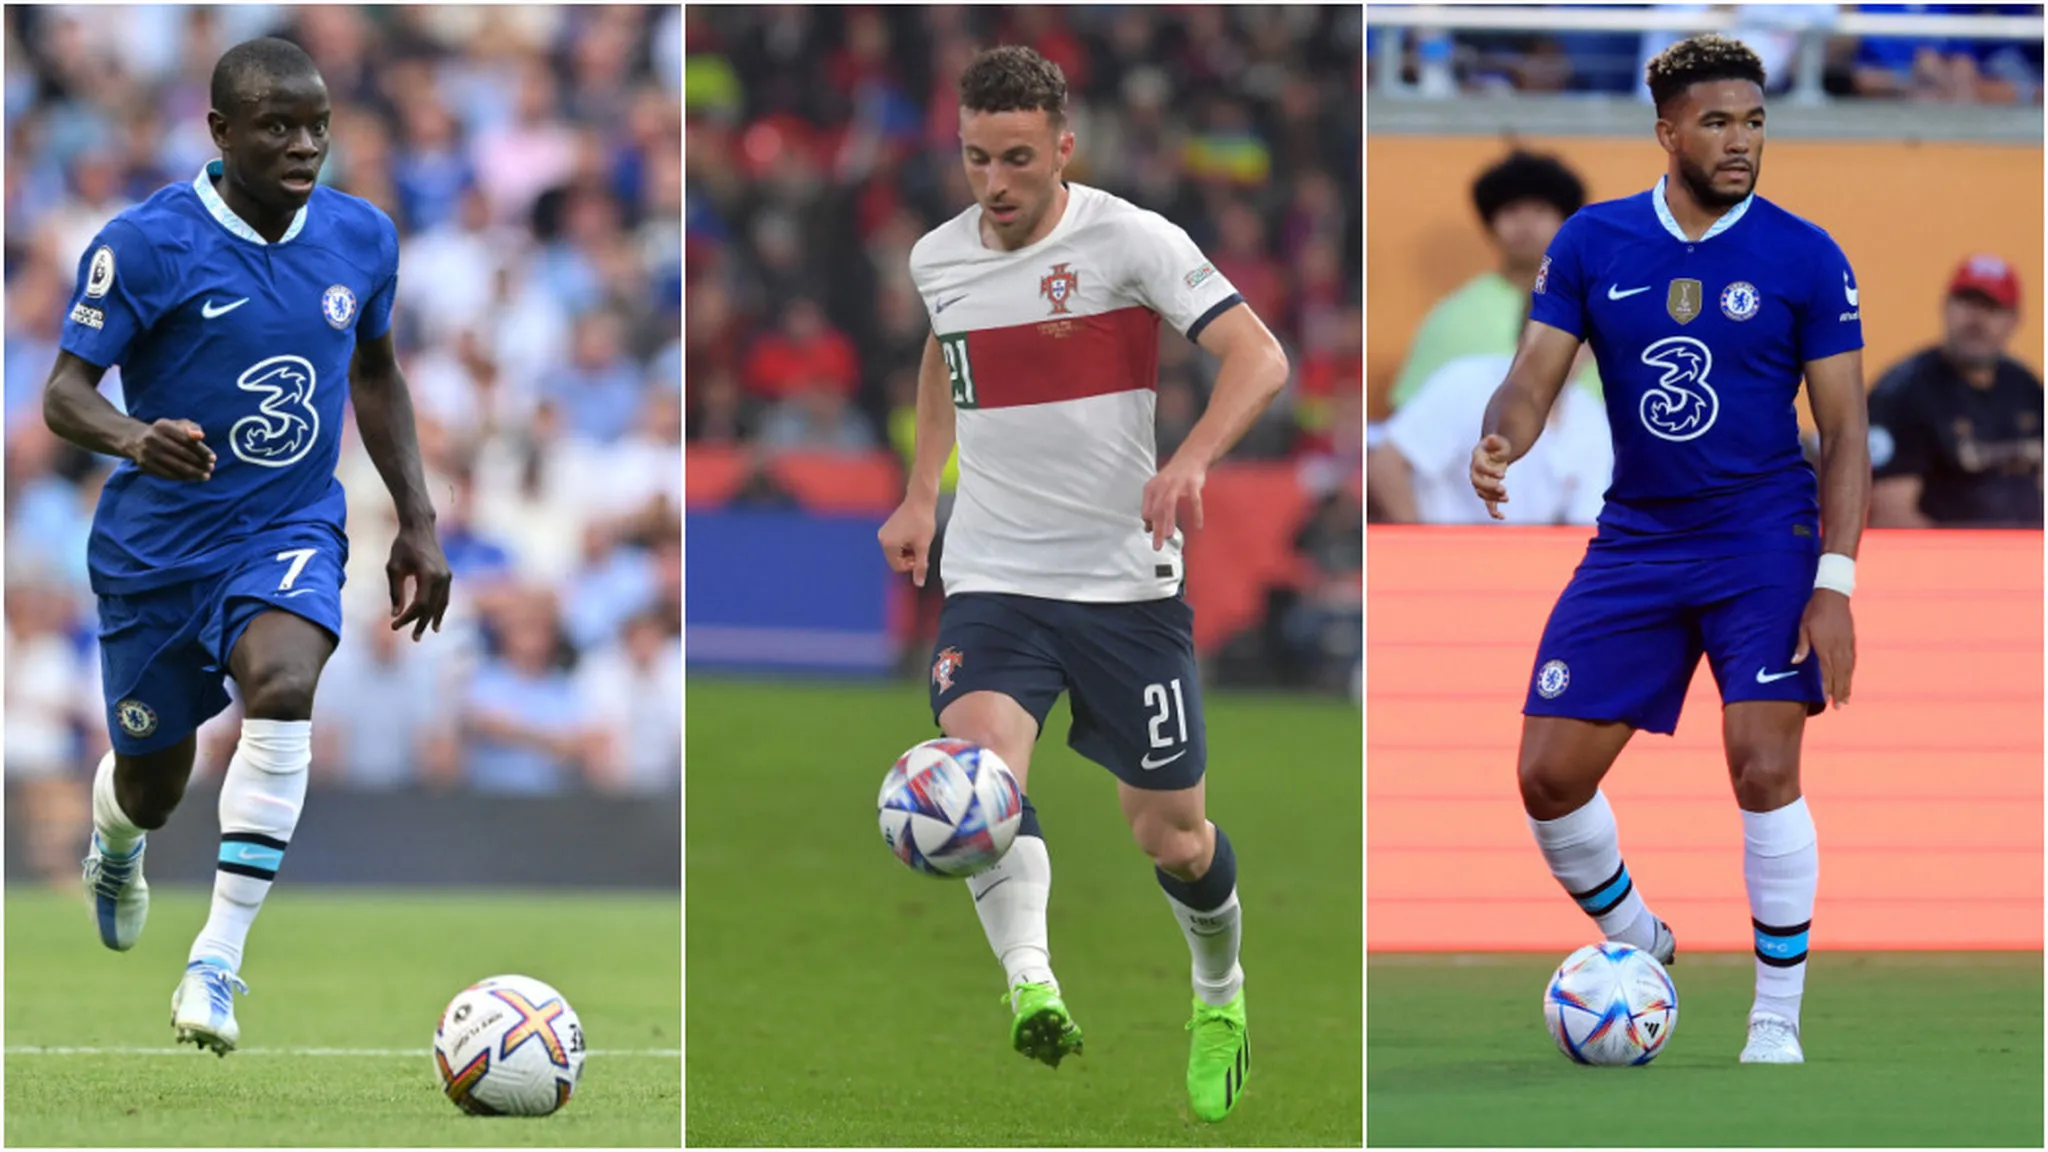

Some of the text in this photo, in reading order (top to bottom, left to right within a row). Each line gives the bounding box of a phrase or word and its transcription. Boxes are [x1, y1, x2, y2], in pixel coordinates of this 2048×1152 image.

[941, 338, 975, 404] 21
[1640, 335, 1719, 442] 3
[229, 354, 320, 468] 3
[276, 548, 317, 591] 7
[1143, 678, 1188, 749] 21
